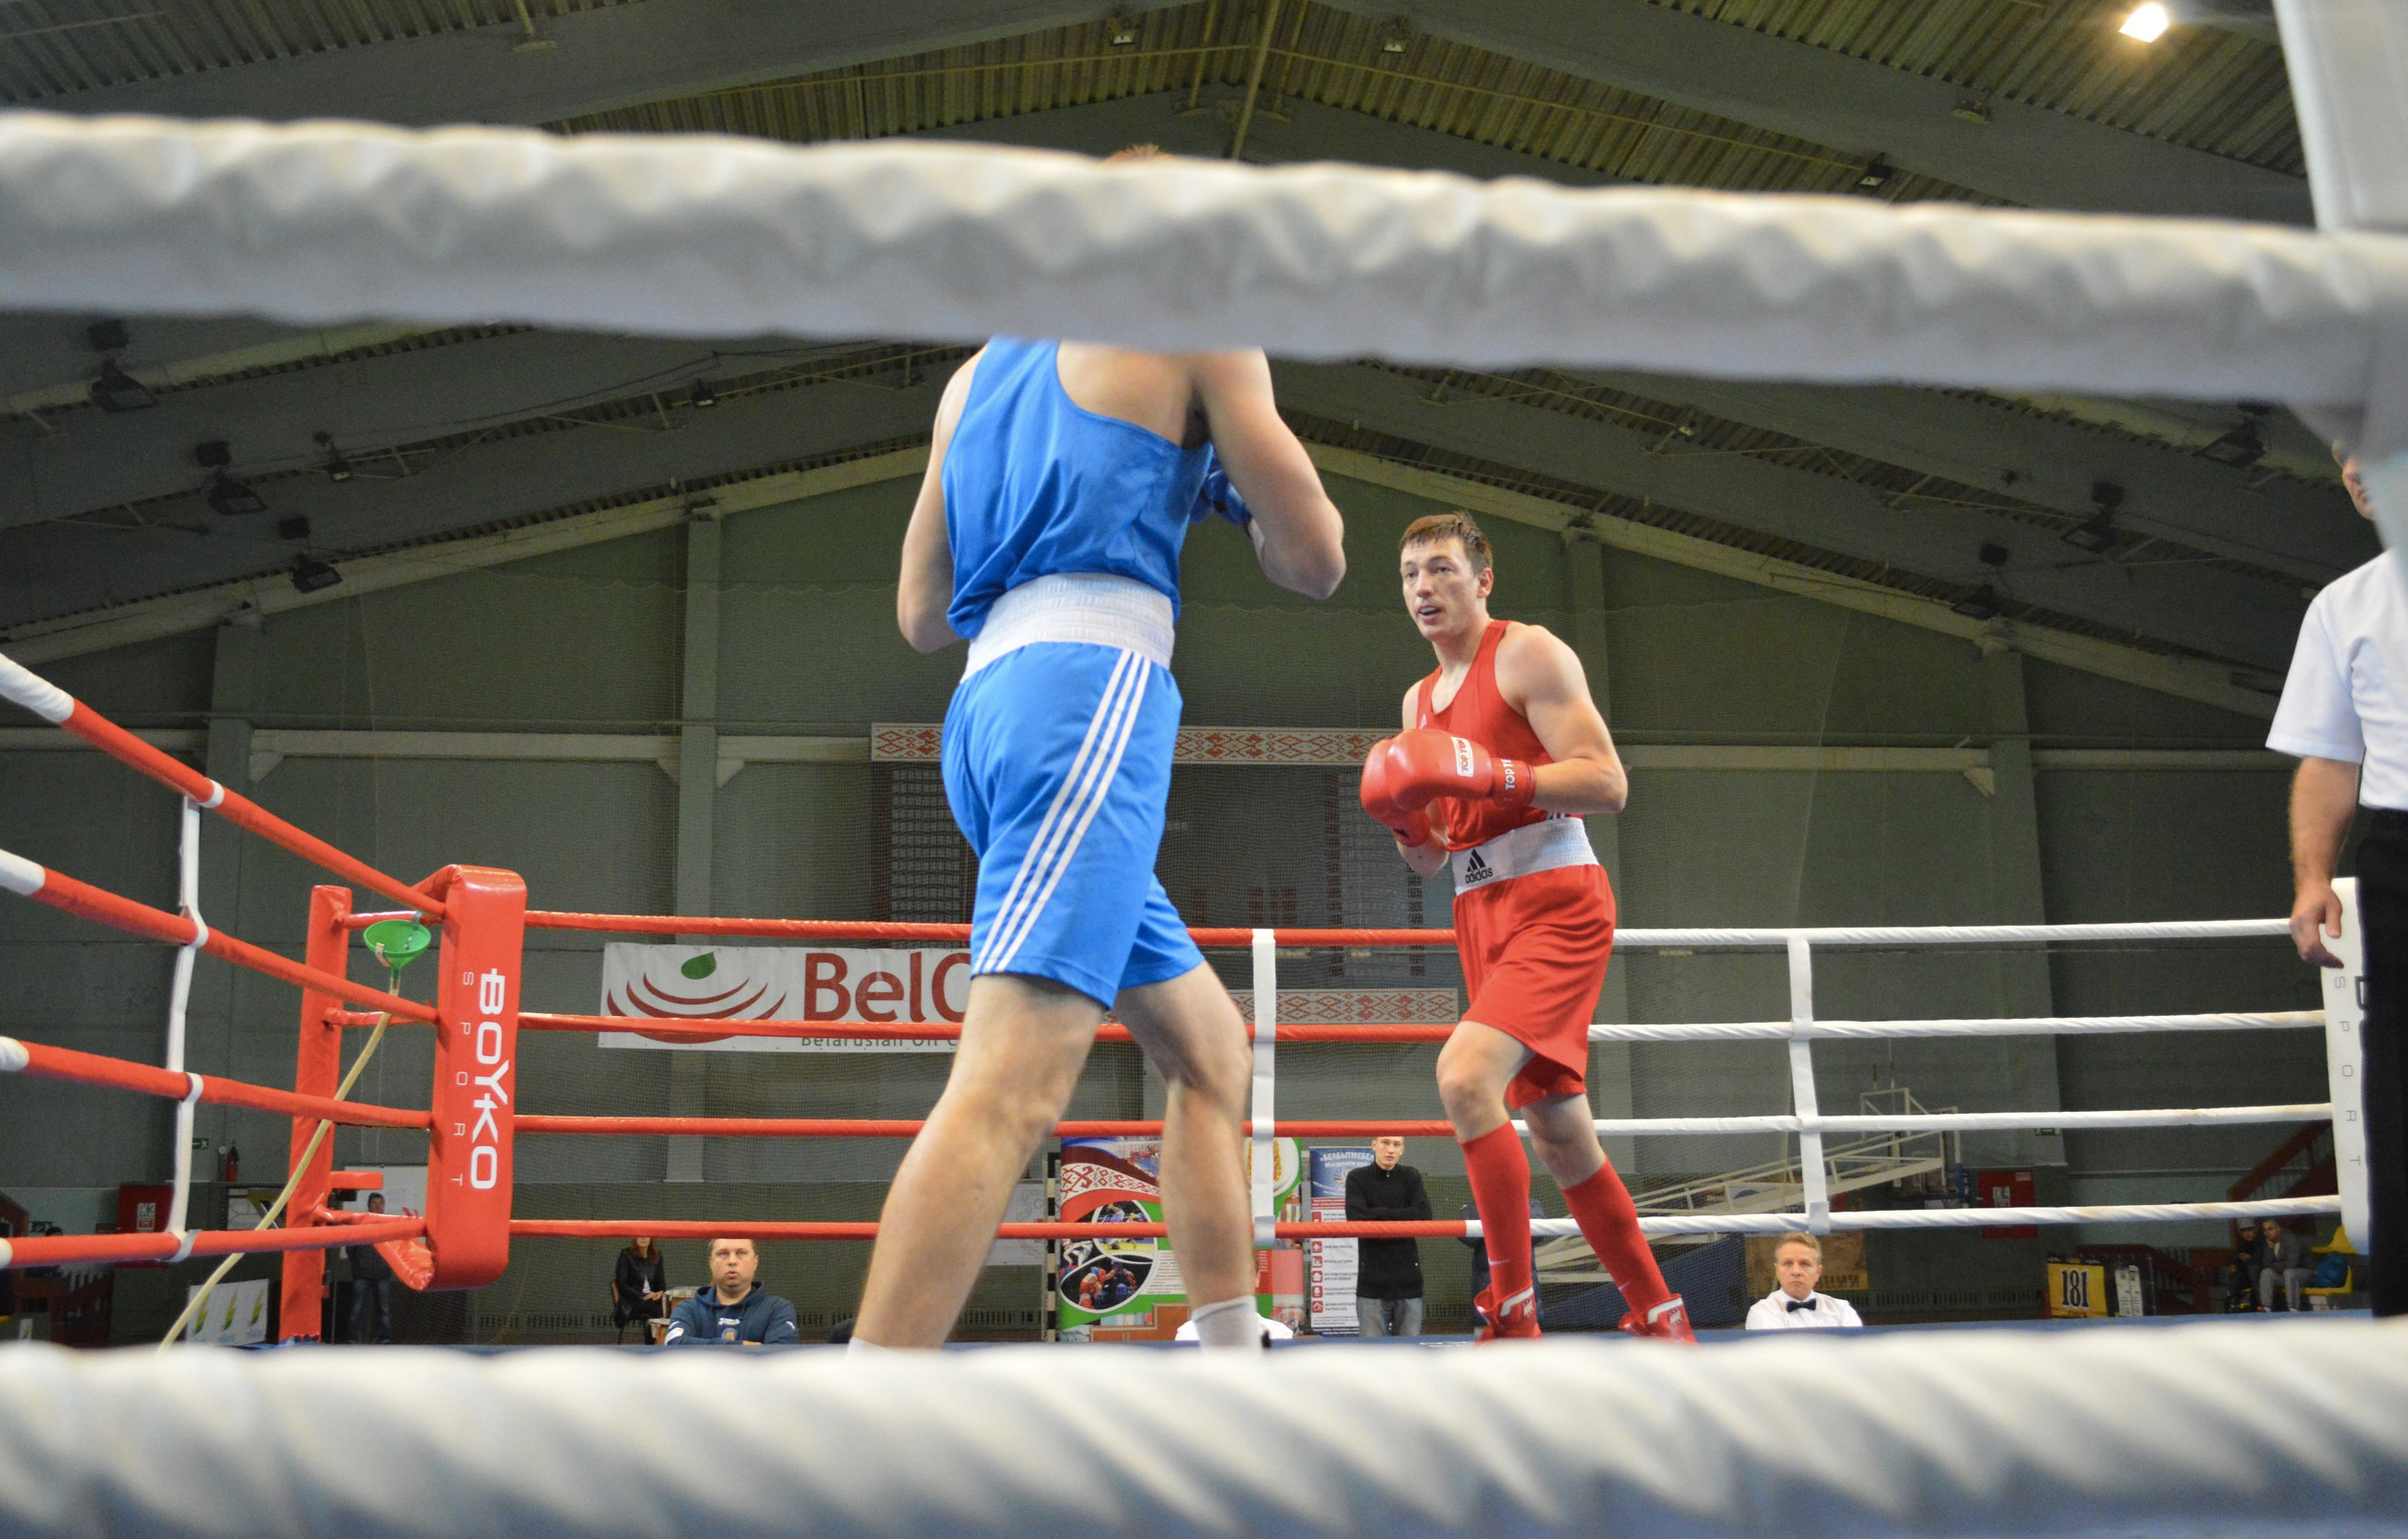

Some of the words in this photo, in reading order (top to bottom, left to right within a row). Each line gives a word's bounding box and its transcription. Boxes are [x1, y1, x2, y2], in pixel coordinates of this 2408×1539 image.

[1505, 769, 1516, 790] TOP
[1465, 866, 1494, 884] adidas
[452, 971, 474, 1186] SPORT
[470, 968, 509, 1189] BOYKO
[2334, 976, 2361, 1166] SPORT
[2061, 1269, 2090, 1309] 181
